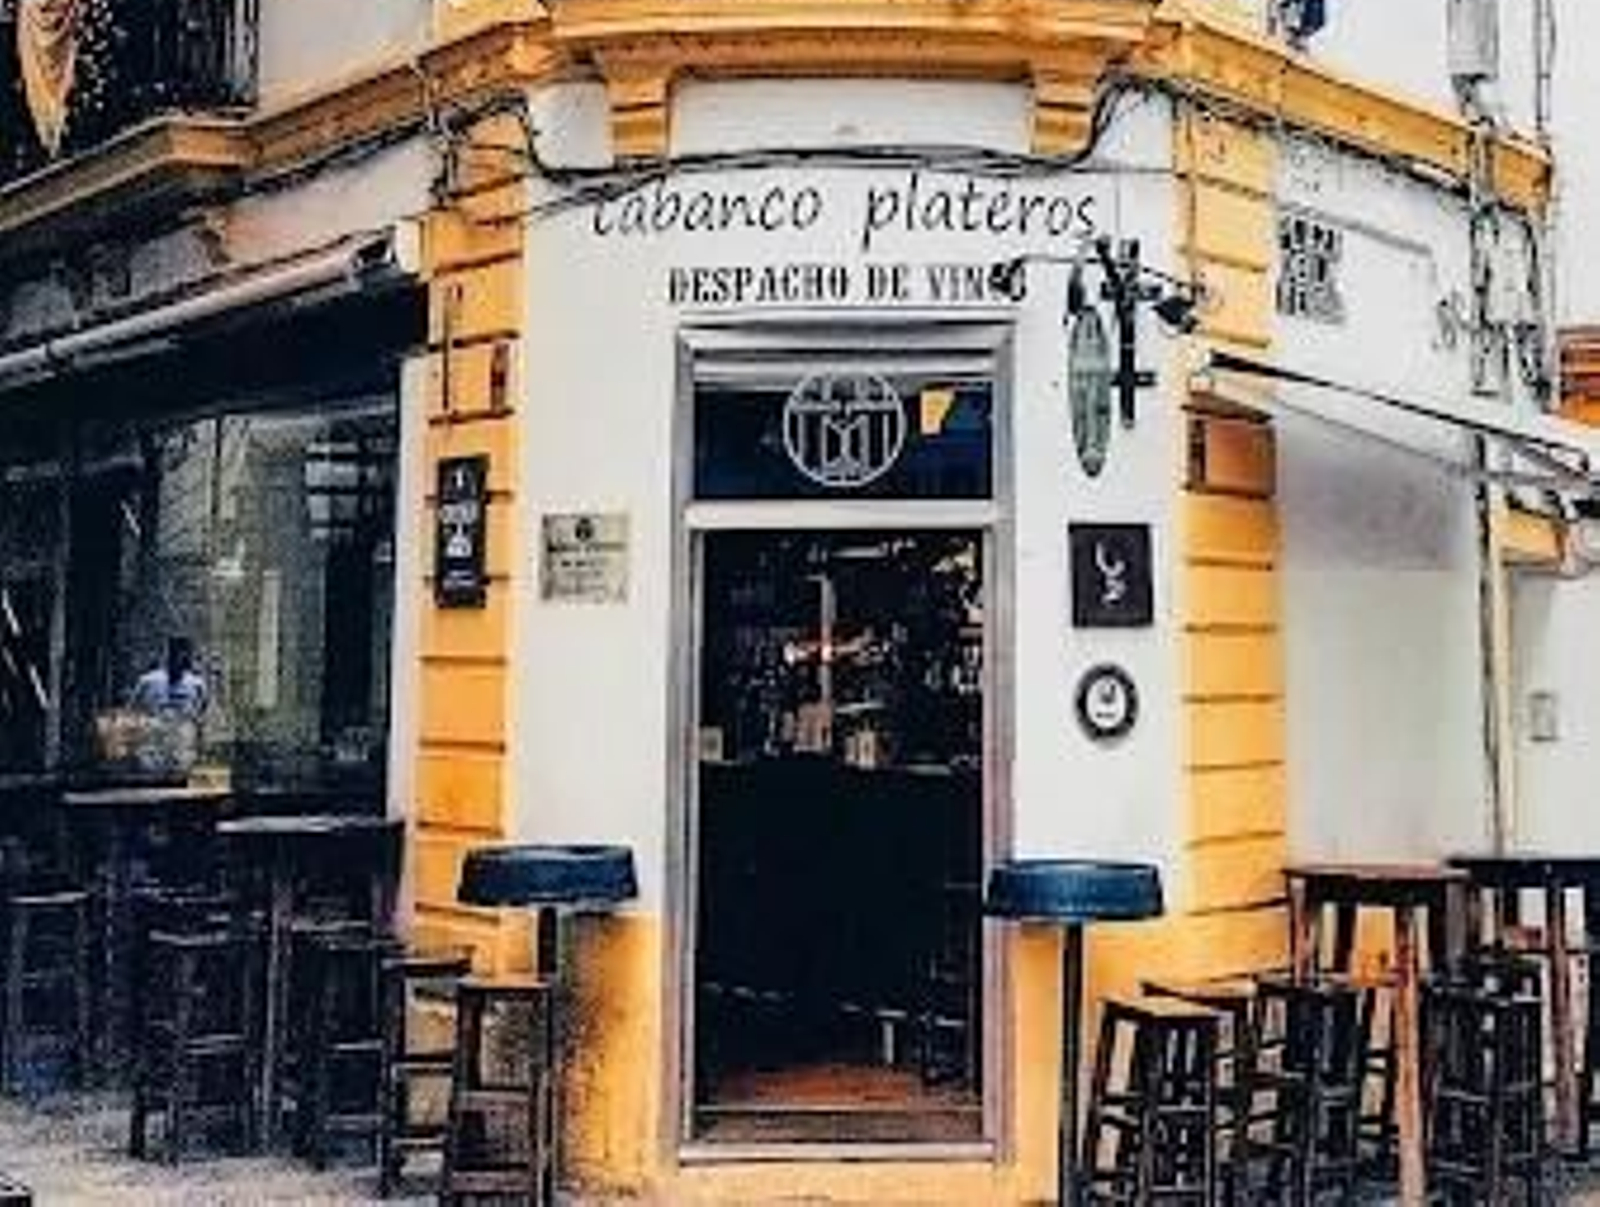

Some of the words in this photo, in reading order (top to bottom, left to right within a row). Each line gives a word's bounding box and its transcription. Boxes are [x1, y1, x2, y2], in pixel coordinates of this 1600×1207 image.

[863, 172, 1095, 249] plateros
[669, 265, 849, 303] DESPACHO
[868, 265, 908, 299] DE
